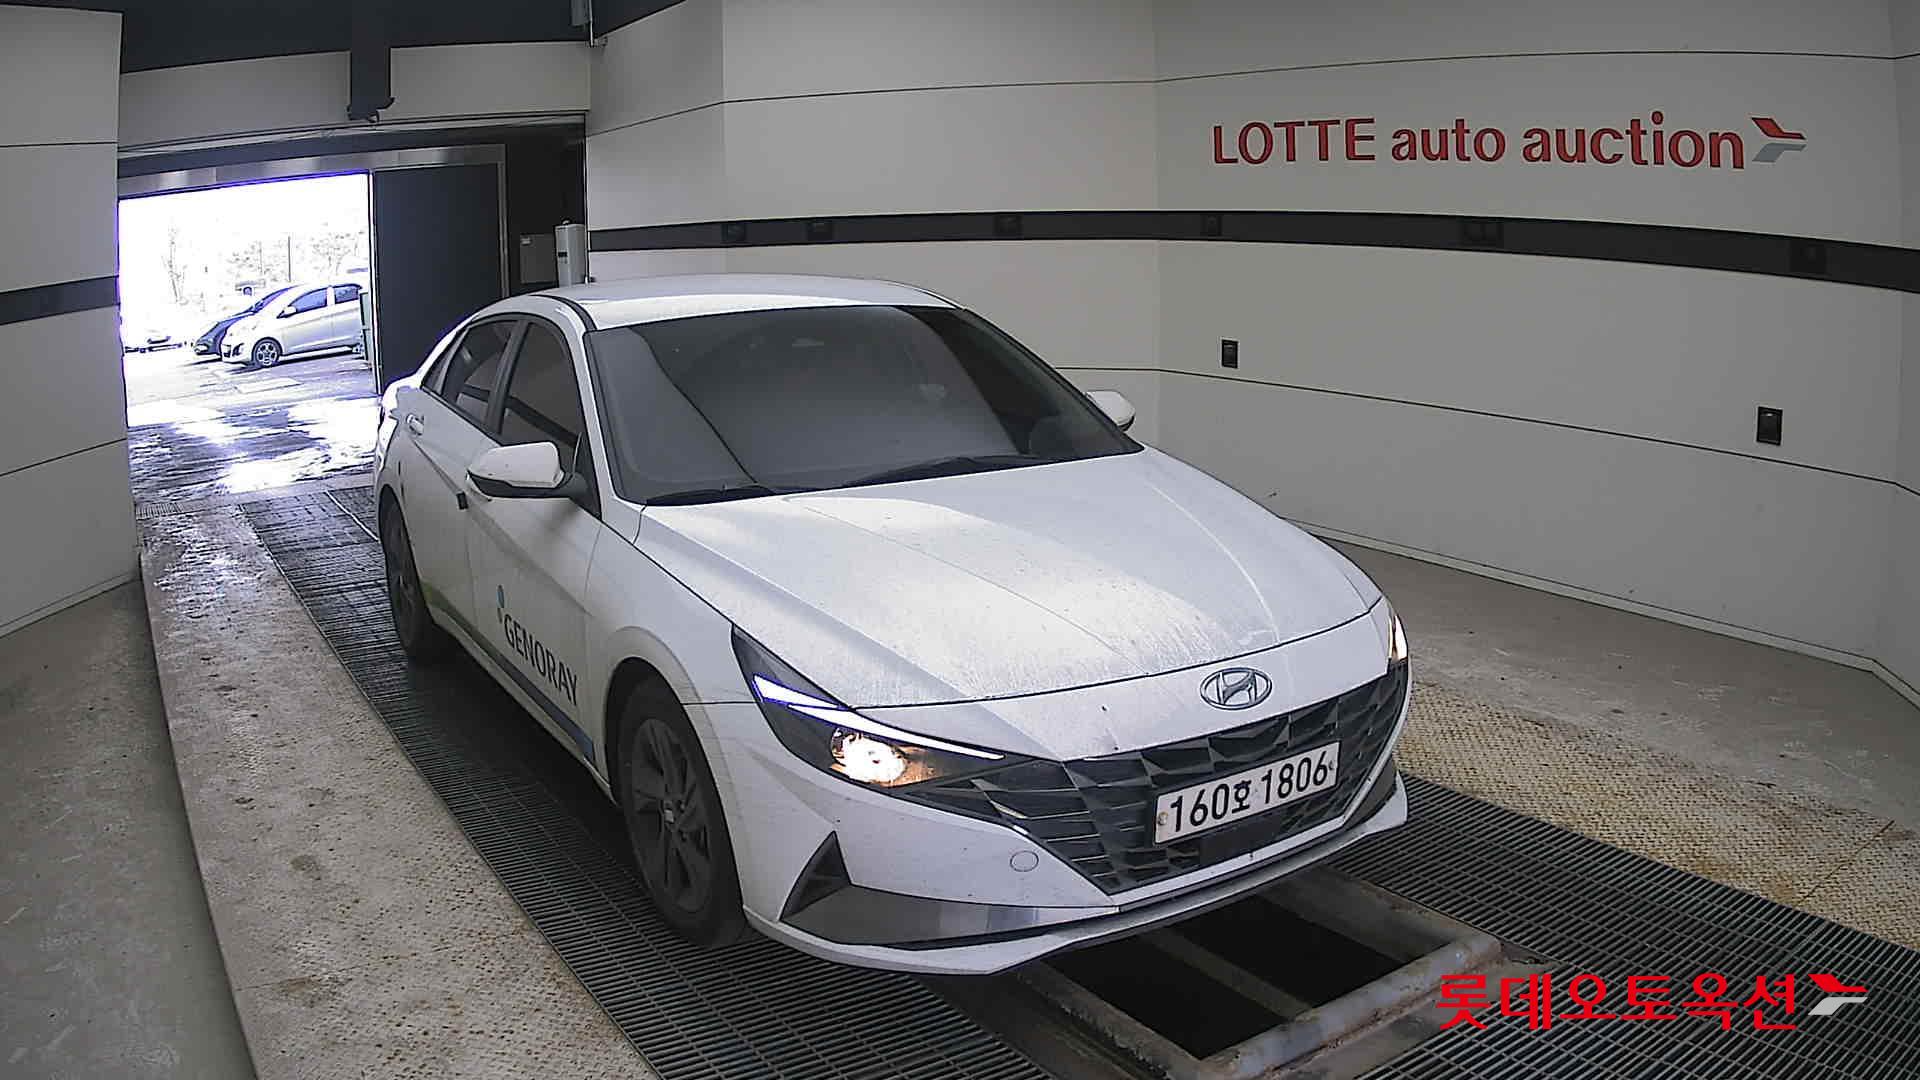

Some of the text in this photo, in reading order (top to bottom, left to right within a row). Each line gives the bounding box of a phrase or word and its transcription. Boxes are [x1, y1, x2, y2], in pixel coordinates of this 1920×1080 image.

[1213, 111, 1745, 170] LOTTE auto auction
[504, 614, 577, 706] GENORAY
[1170, 751, 1329, 832] 160호 1806
